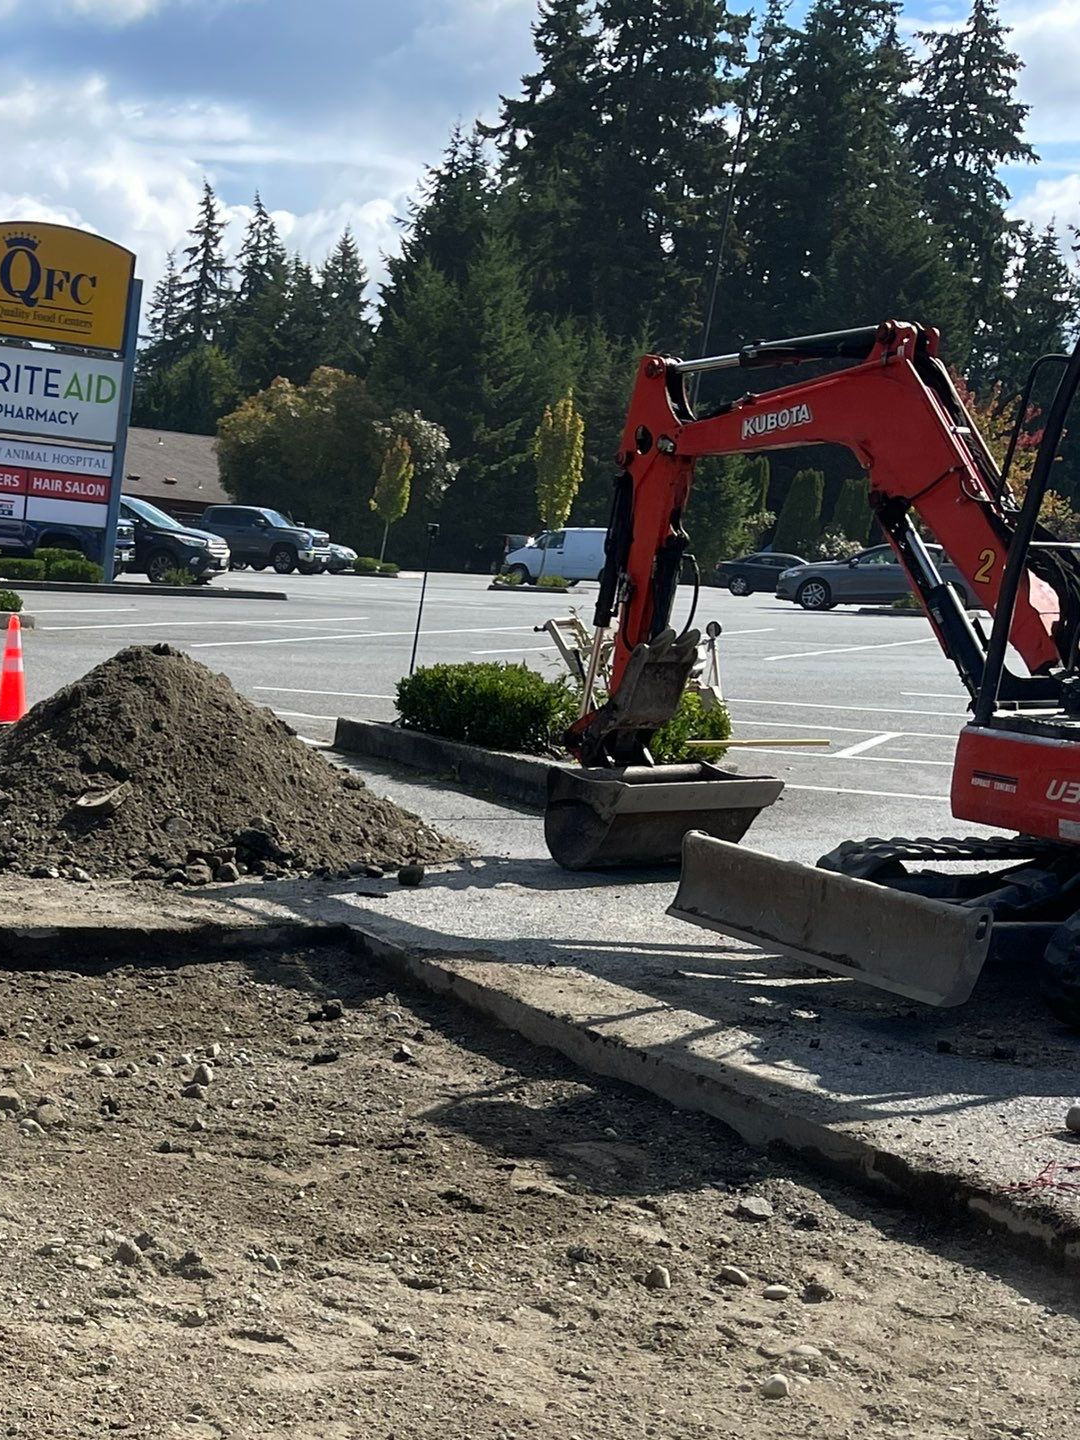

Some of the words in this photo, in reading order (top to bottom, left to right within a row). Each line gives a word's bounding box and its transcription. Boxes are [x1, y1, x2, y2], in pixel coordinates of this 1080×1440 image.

[0, 248, 97, 307] QFC
[33, 310, 56, 324] Food
[58, 314, 93, 328] Centers
[63, 373, 116, 404] AID
[742, 403, 811, 438] KUBOTA
[5, 448, 49, 463] ANIMAL
[52, 454, 108, 470] HOSPITAL
[33, 477, 62, 492] HAIR
[65, 480, 105, 497] SALON
[973, 548, 996, 584] 2
[1045, 779, 1080, 804] U3
